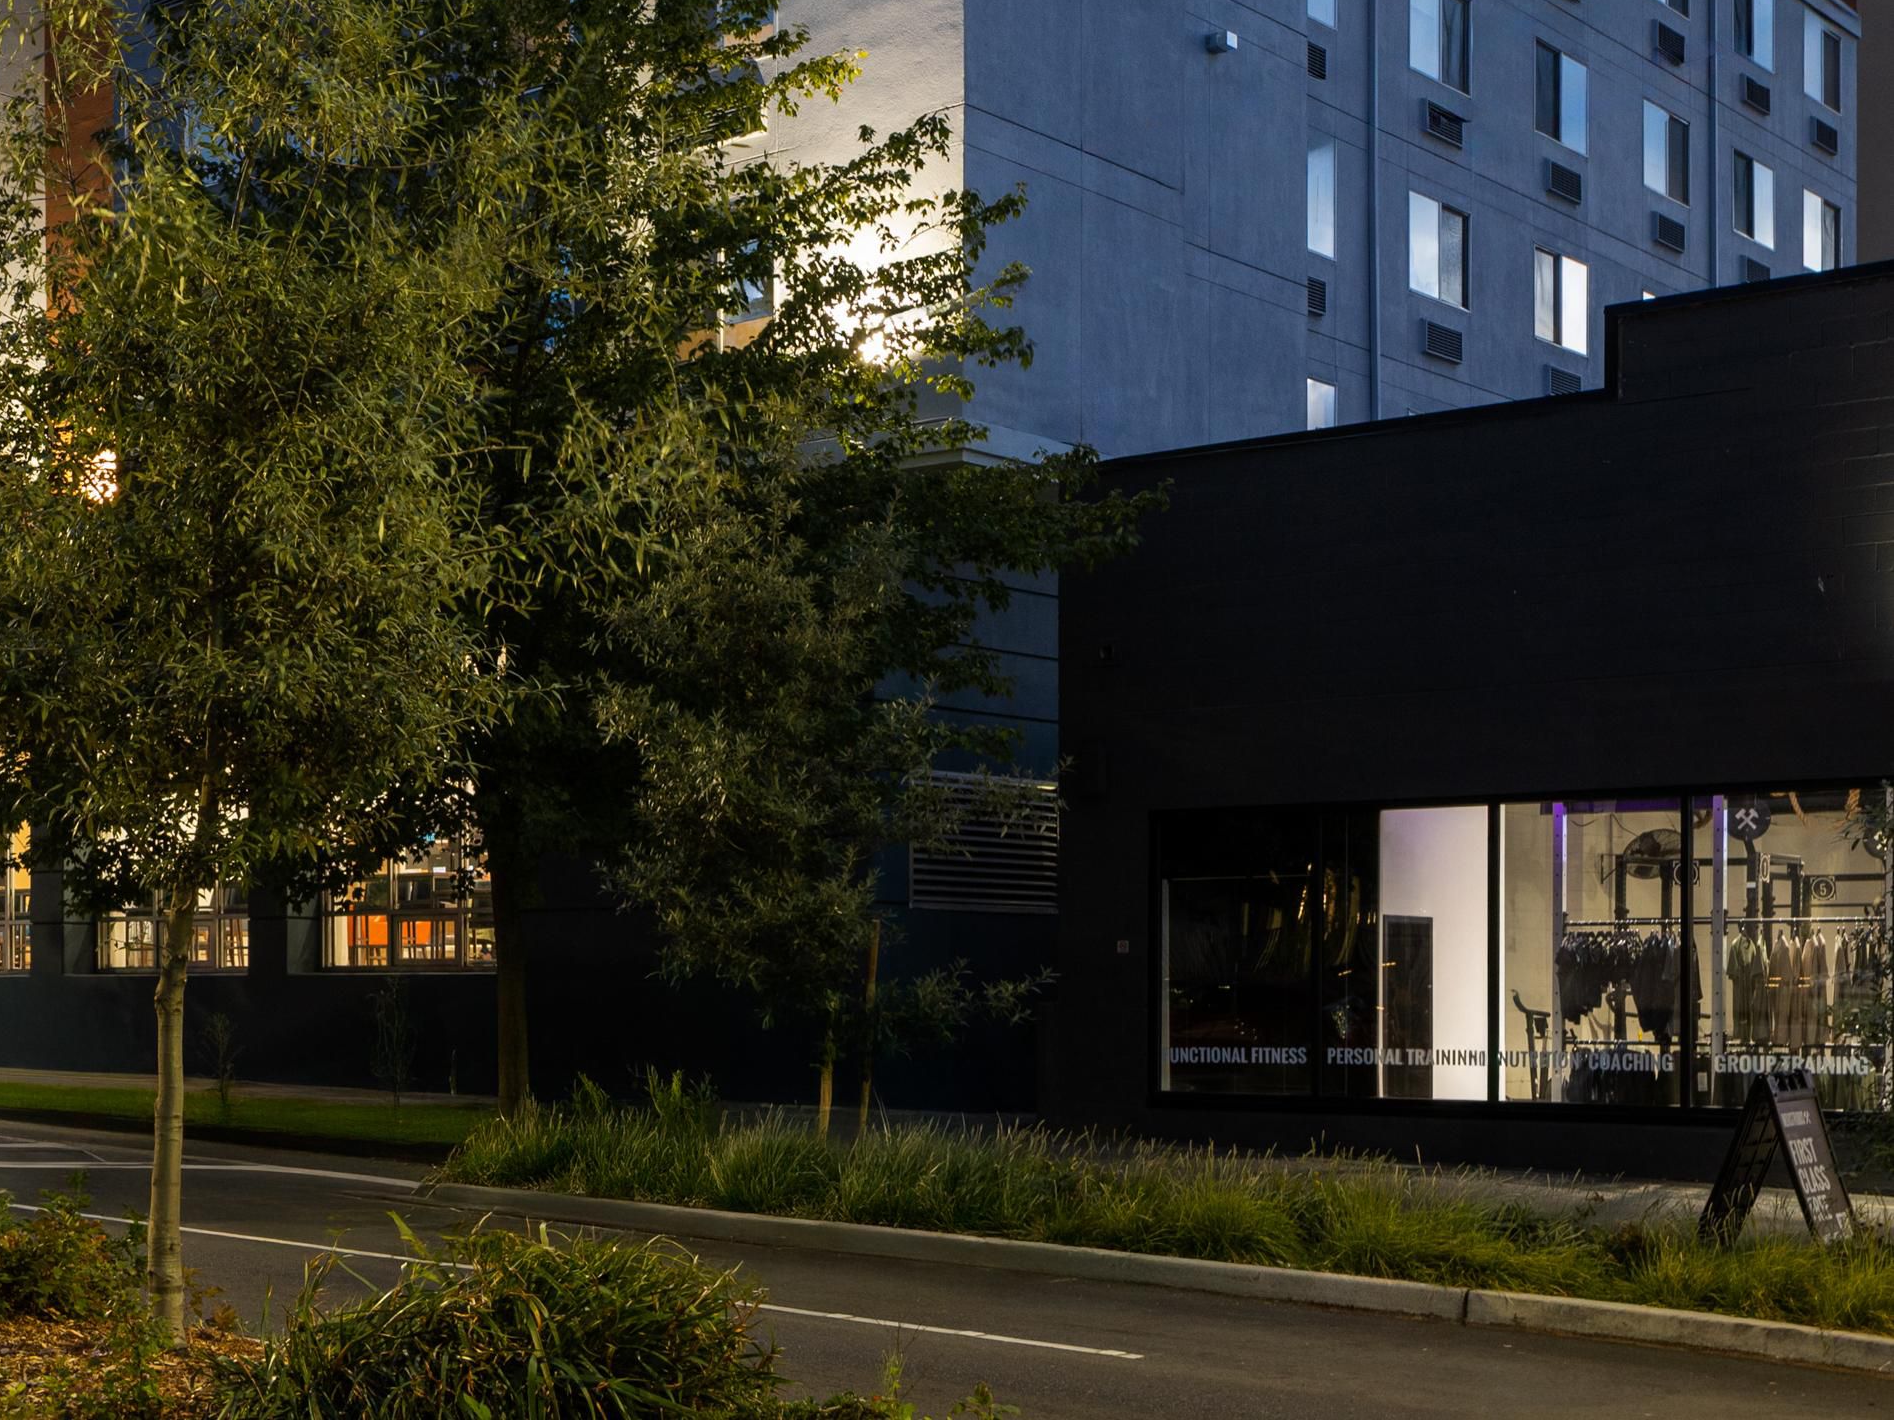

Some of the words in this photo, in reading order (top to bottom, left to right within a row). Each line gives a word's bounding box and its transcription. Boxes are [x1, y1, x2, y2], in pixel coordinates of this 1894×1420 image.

[1168, 1046, 1248, 1064] UNCTIONAL
[1250, 1046, 1308, 1065] FITNESS
[1326, 1048, 1403, 1066] PERSONAL
[1588, 1051, 1674, 1072] COACHING
[1714, 1054, 1777, 1075] GROUP
[1779, 1055, 1870, 1077] TRAINING
[1789, 1137, 1817, 1165] FIRST
[1798, 1165, 1831, 1194] CLASS
